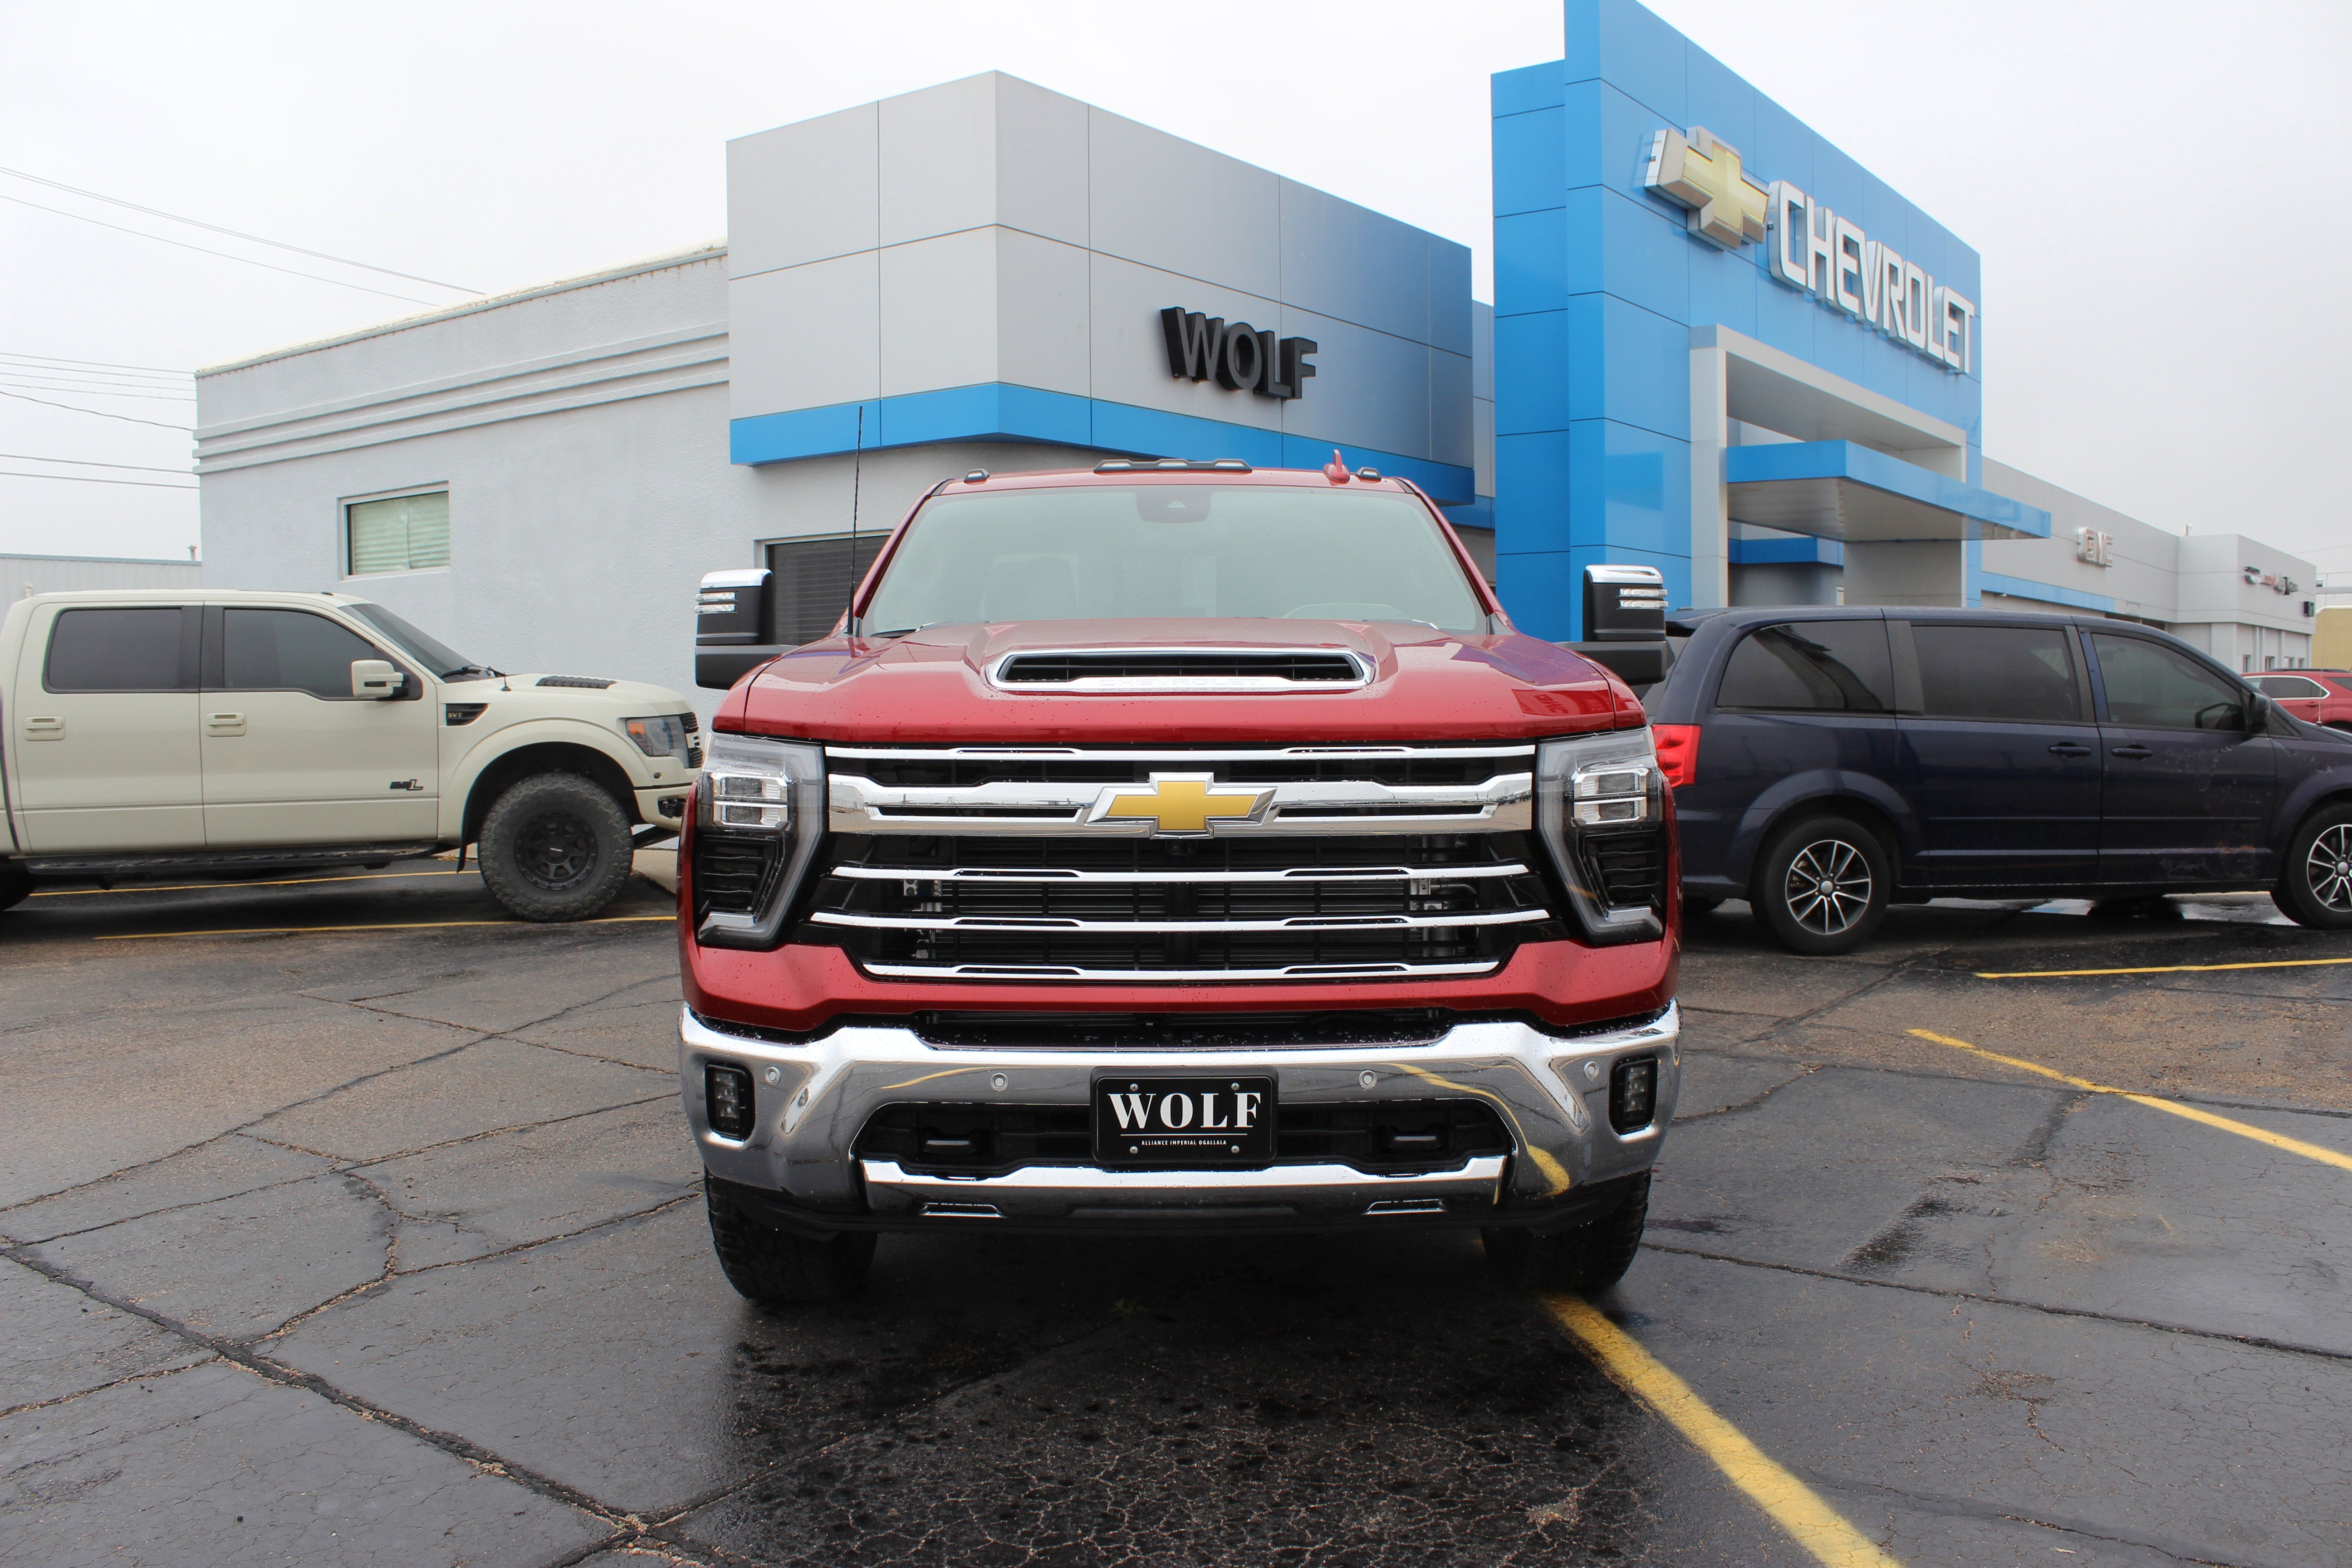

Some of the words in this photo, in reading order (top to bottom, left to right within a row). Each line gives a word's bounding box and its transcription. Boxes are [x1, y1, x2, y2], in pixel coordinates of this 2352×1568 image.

[1768, 180, 1975, 375] CHEVROLET
[1161, 306, 1318, 399] WOLF
[1107, 1092, 1261, 1129] WOLF
